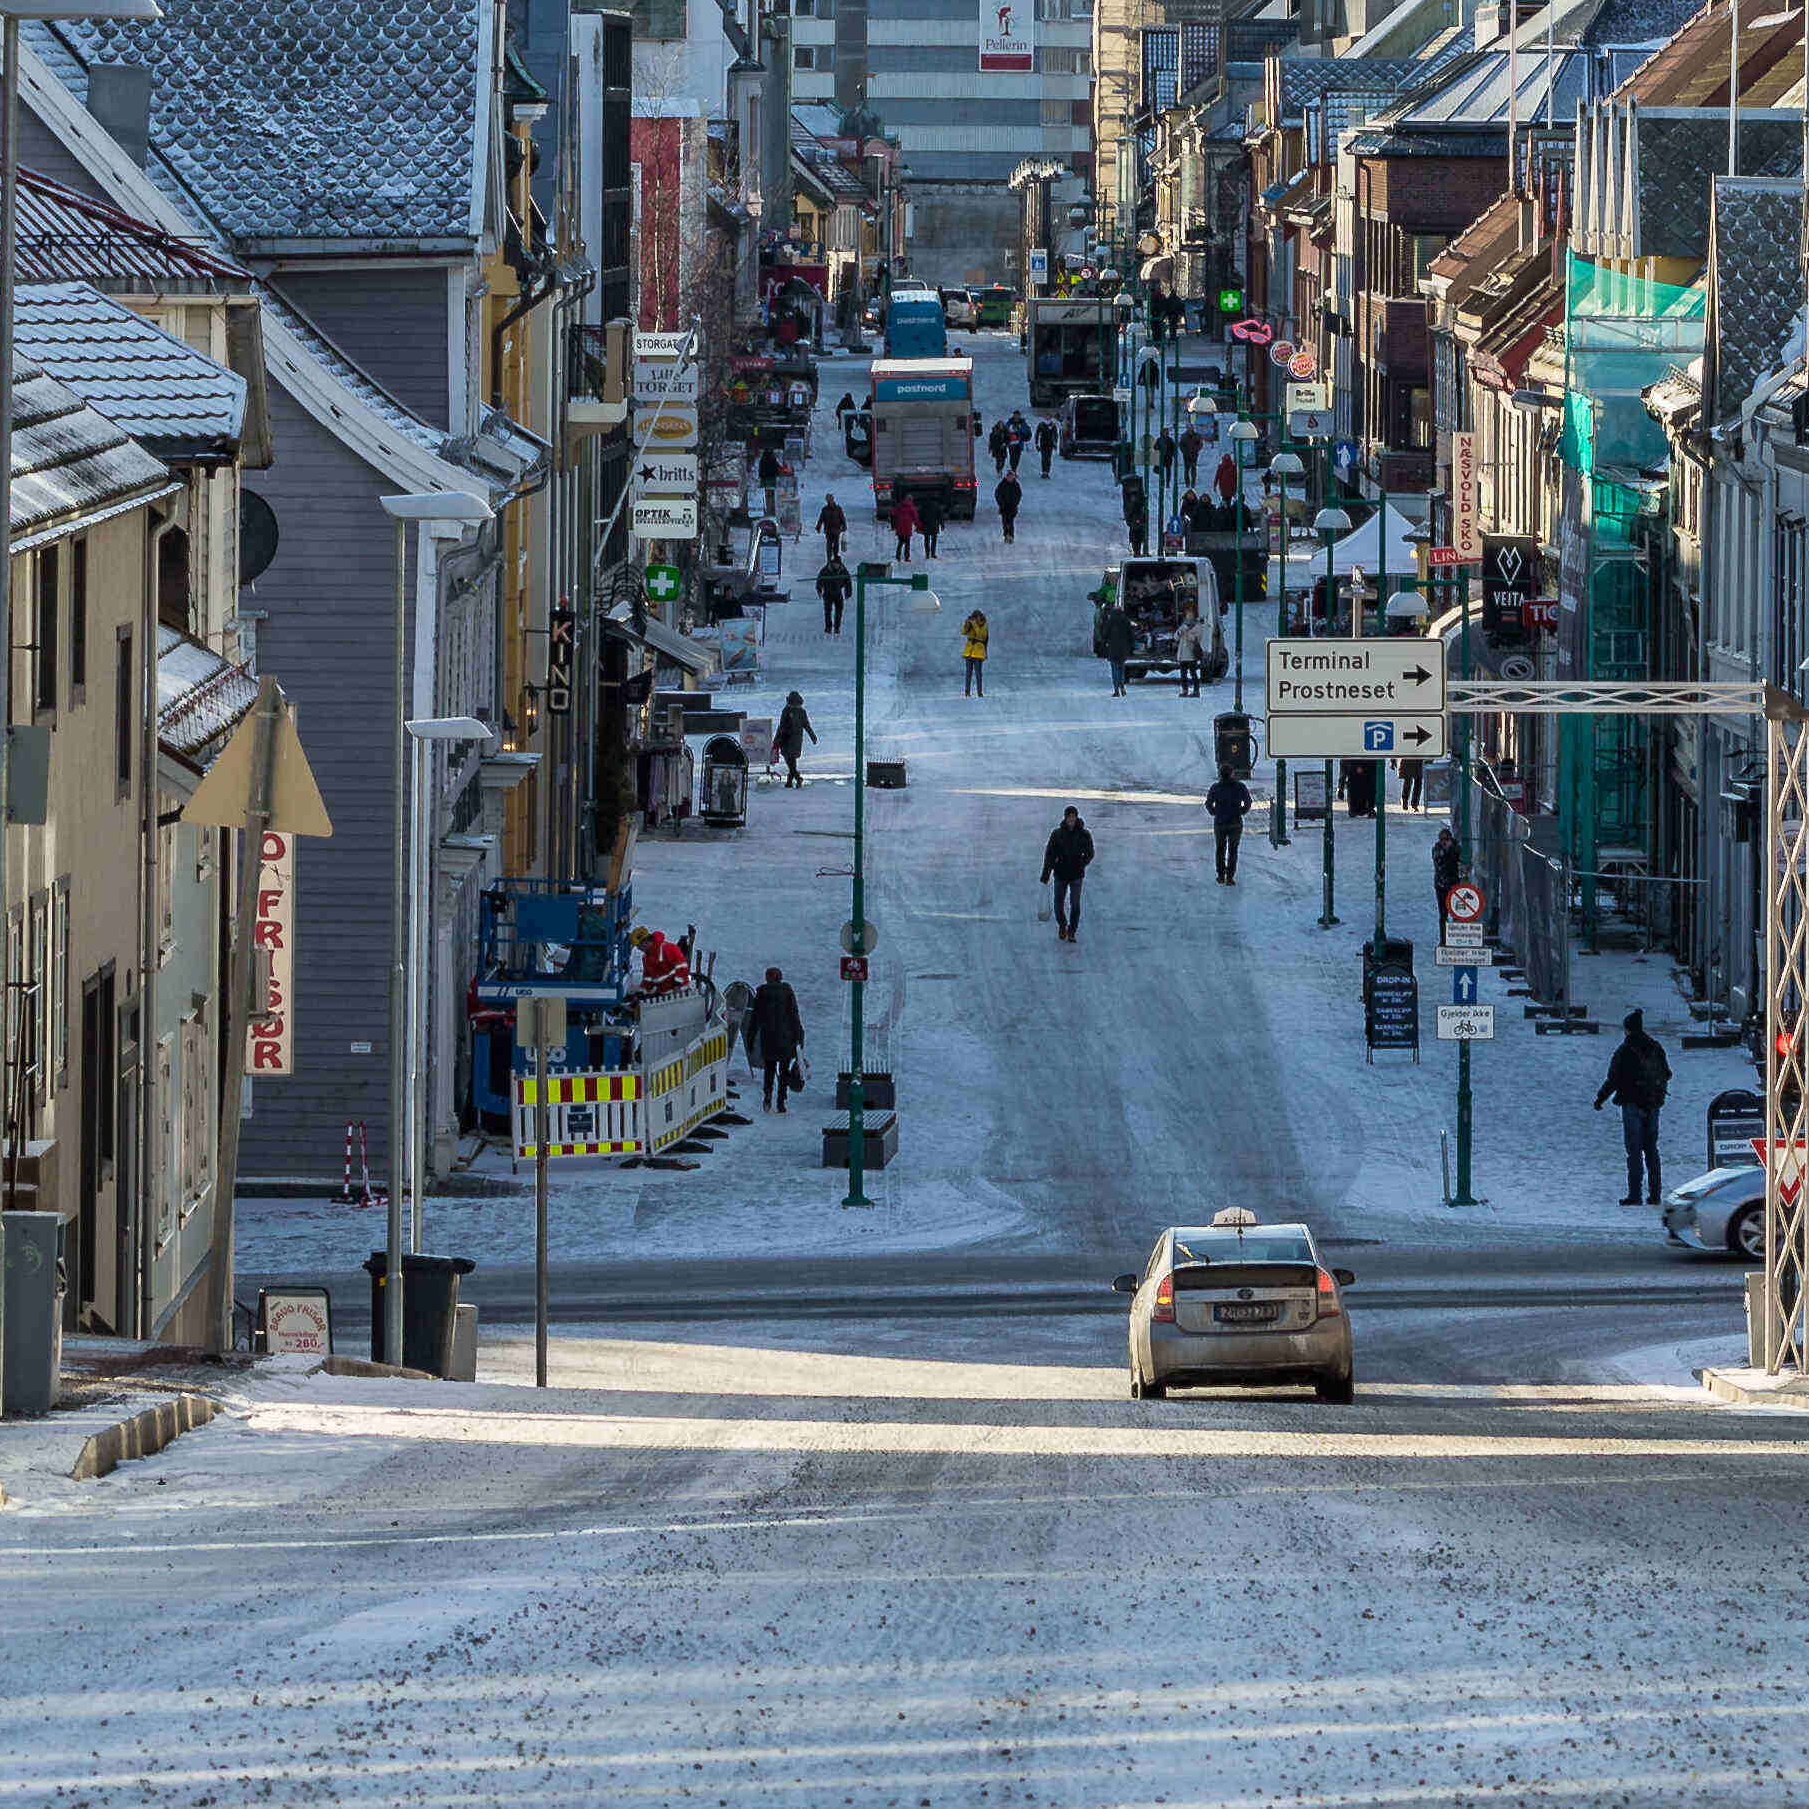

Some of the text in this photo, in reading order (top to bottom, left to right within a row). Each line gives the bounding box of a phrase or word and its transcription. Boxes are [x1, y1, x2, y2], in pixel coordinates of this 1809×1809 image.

[982, 38, 1028, 51] Pellerin
[896, 384, 947, 395] postnord
[659, 464, 695, 482] britts
[1460, 437, 1472, 552] NÆSVOLD SKO
[634, 508, 671, 519] OPTIK
[1493, 591, 1526, 608] VEITA
[551, 620, 572, 711] KINO
[1278, 651, 1370, 670] Terminal
[1278, 680, 1395, 700] Prostneset
[1440, 1009, 1490, 1020] Gjelder ikke
